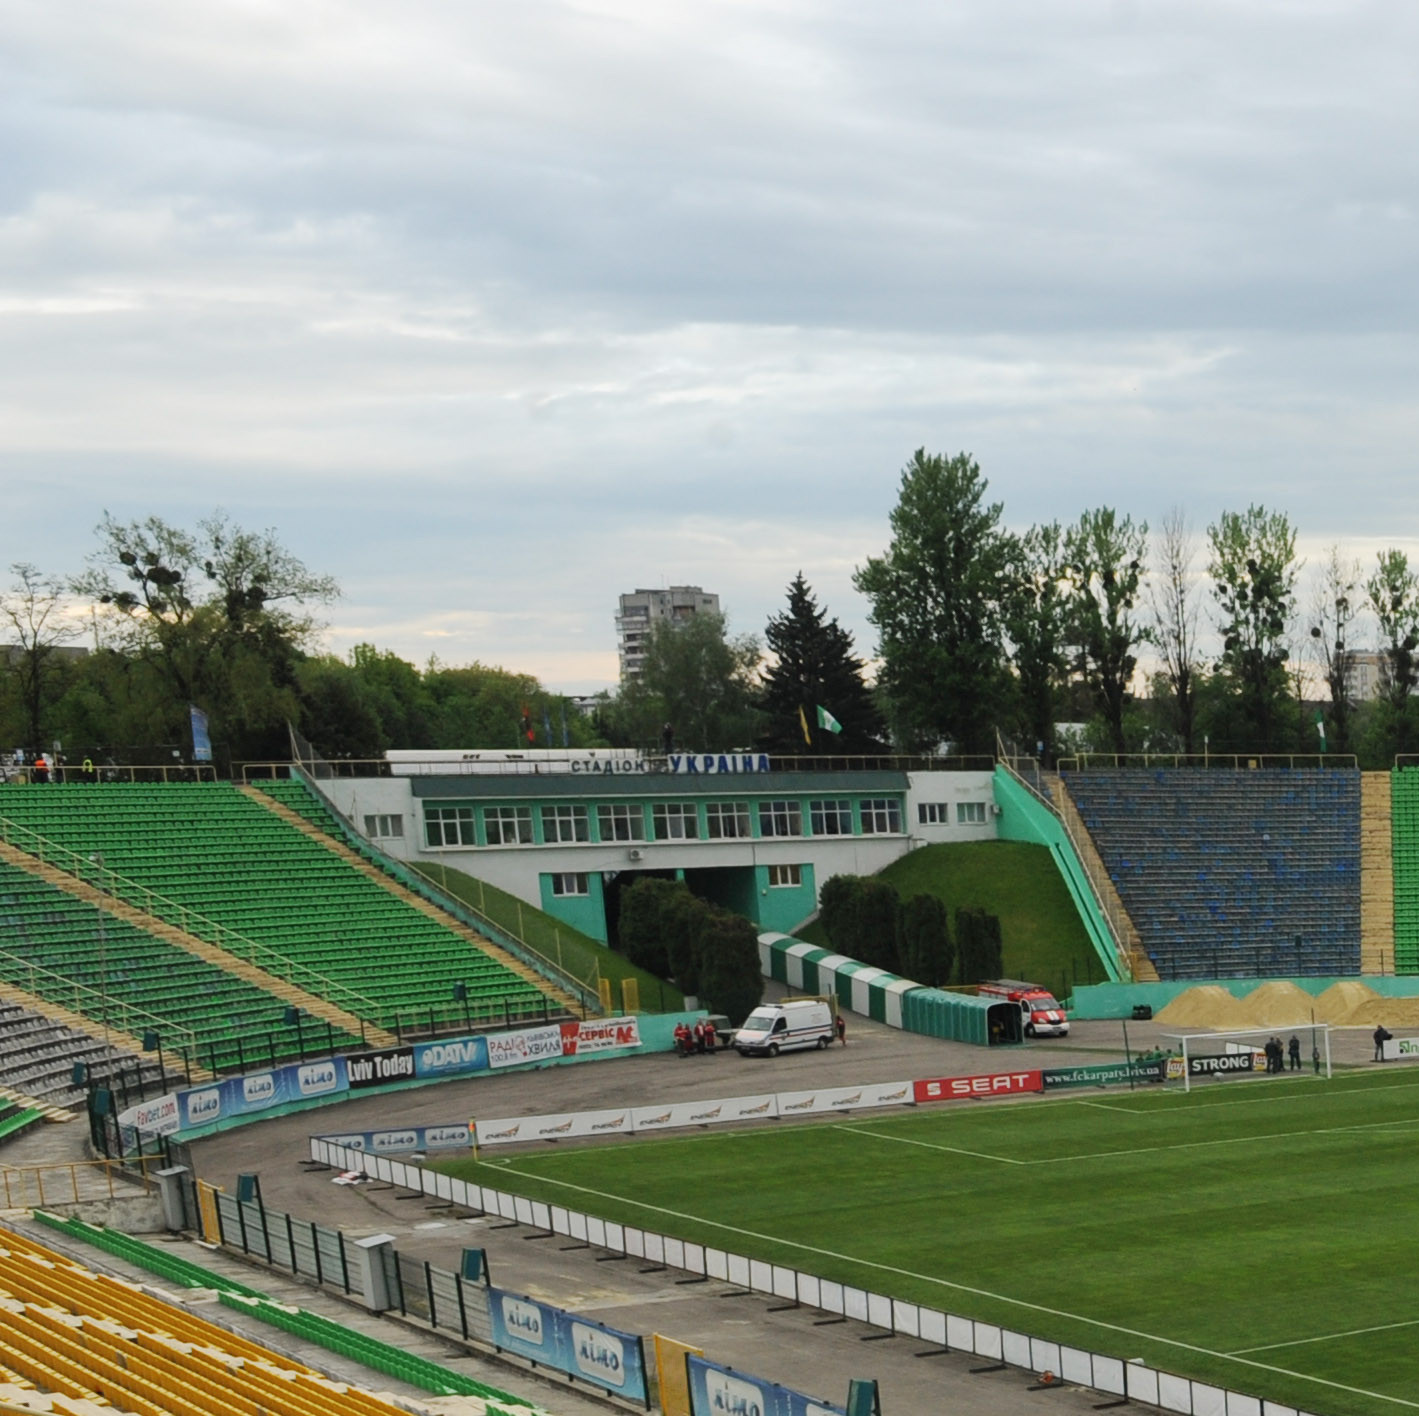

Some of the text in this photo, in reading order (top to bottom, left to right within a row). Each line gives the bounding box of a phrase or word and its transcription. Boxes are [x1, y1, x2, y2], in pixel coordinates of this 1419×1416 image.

[571, 759, 645, 775] СТАДІОН
[579, 1027, 615, 1042] СЕРВІС
[347, 1059, 373, 1082] Lviv
[374, 1054, 413, 1079] Today
[1192, 1055, 1250, 1072] STRONG
[1045, 1065, 1160, 1083] www.fckarpaty.lviv.ua
[951, 1073, 1030, 1095] SEAT
